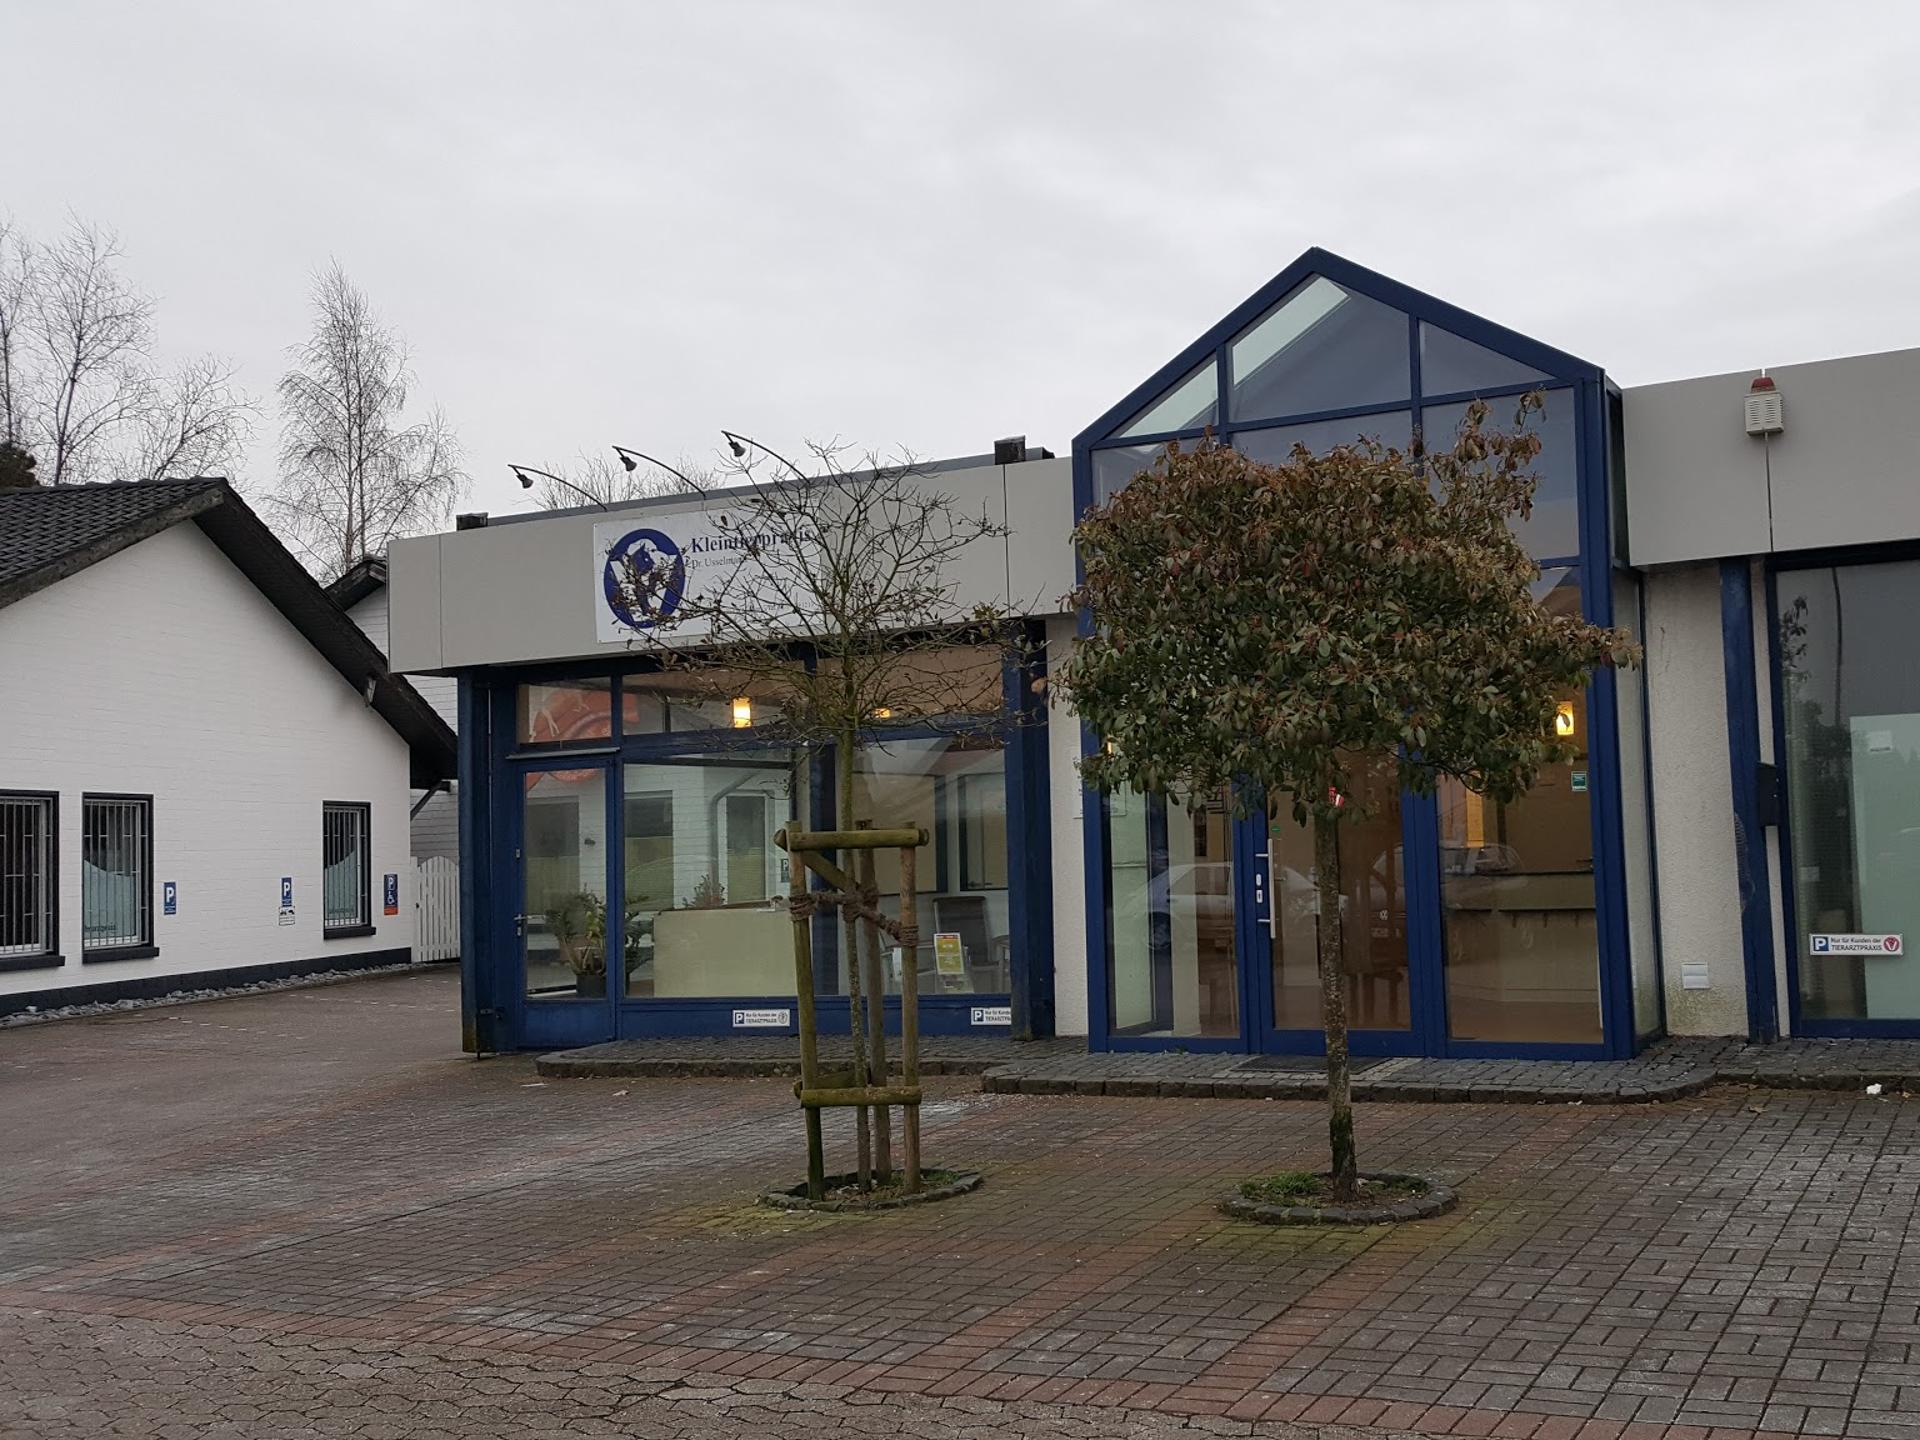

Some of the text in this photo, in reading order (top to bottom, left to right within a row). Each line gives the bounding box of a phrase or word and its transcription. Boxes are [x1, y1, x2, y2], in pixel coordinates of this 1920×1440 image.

[692, 527, 811, 553] Kleintierprais
[166, 887, 174, 903] P
[1814, 938, 1827, 950] P
